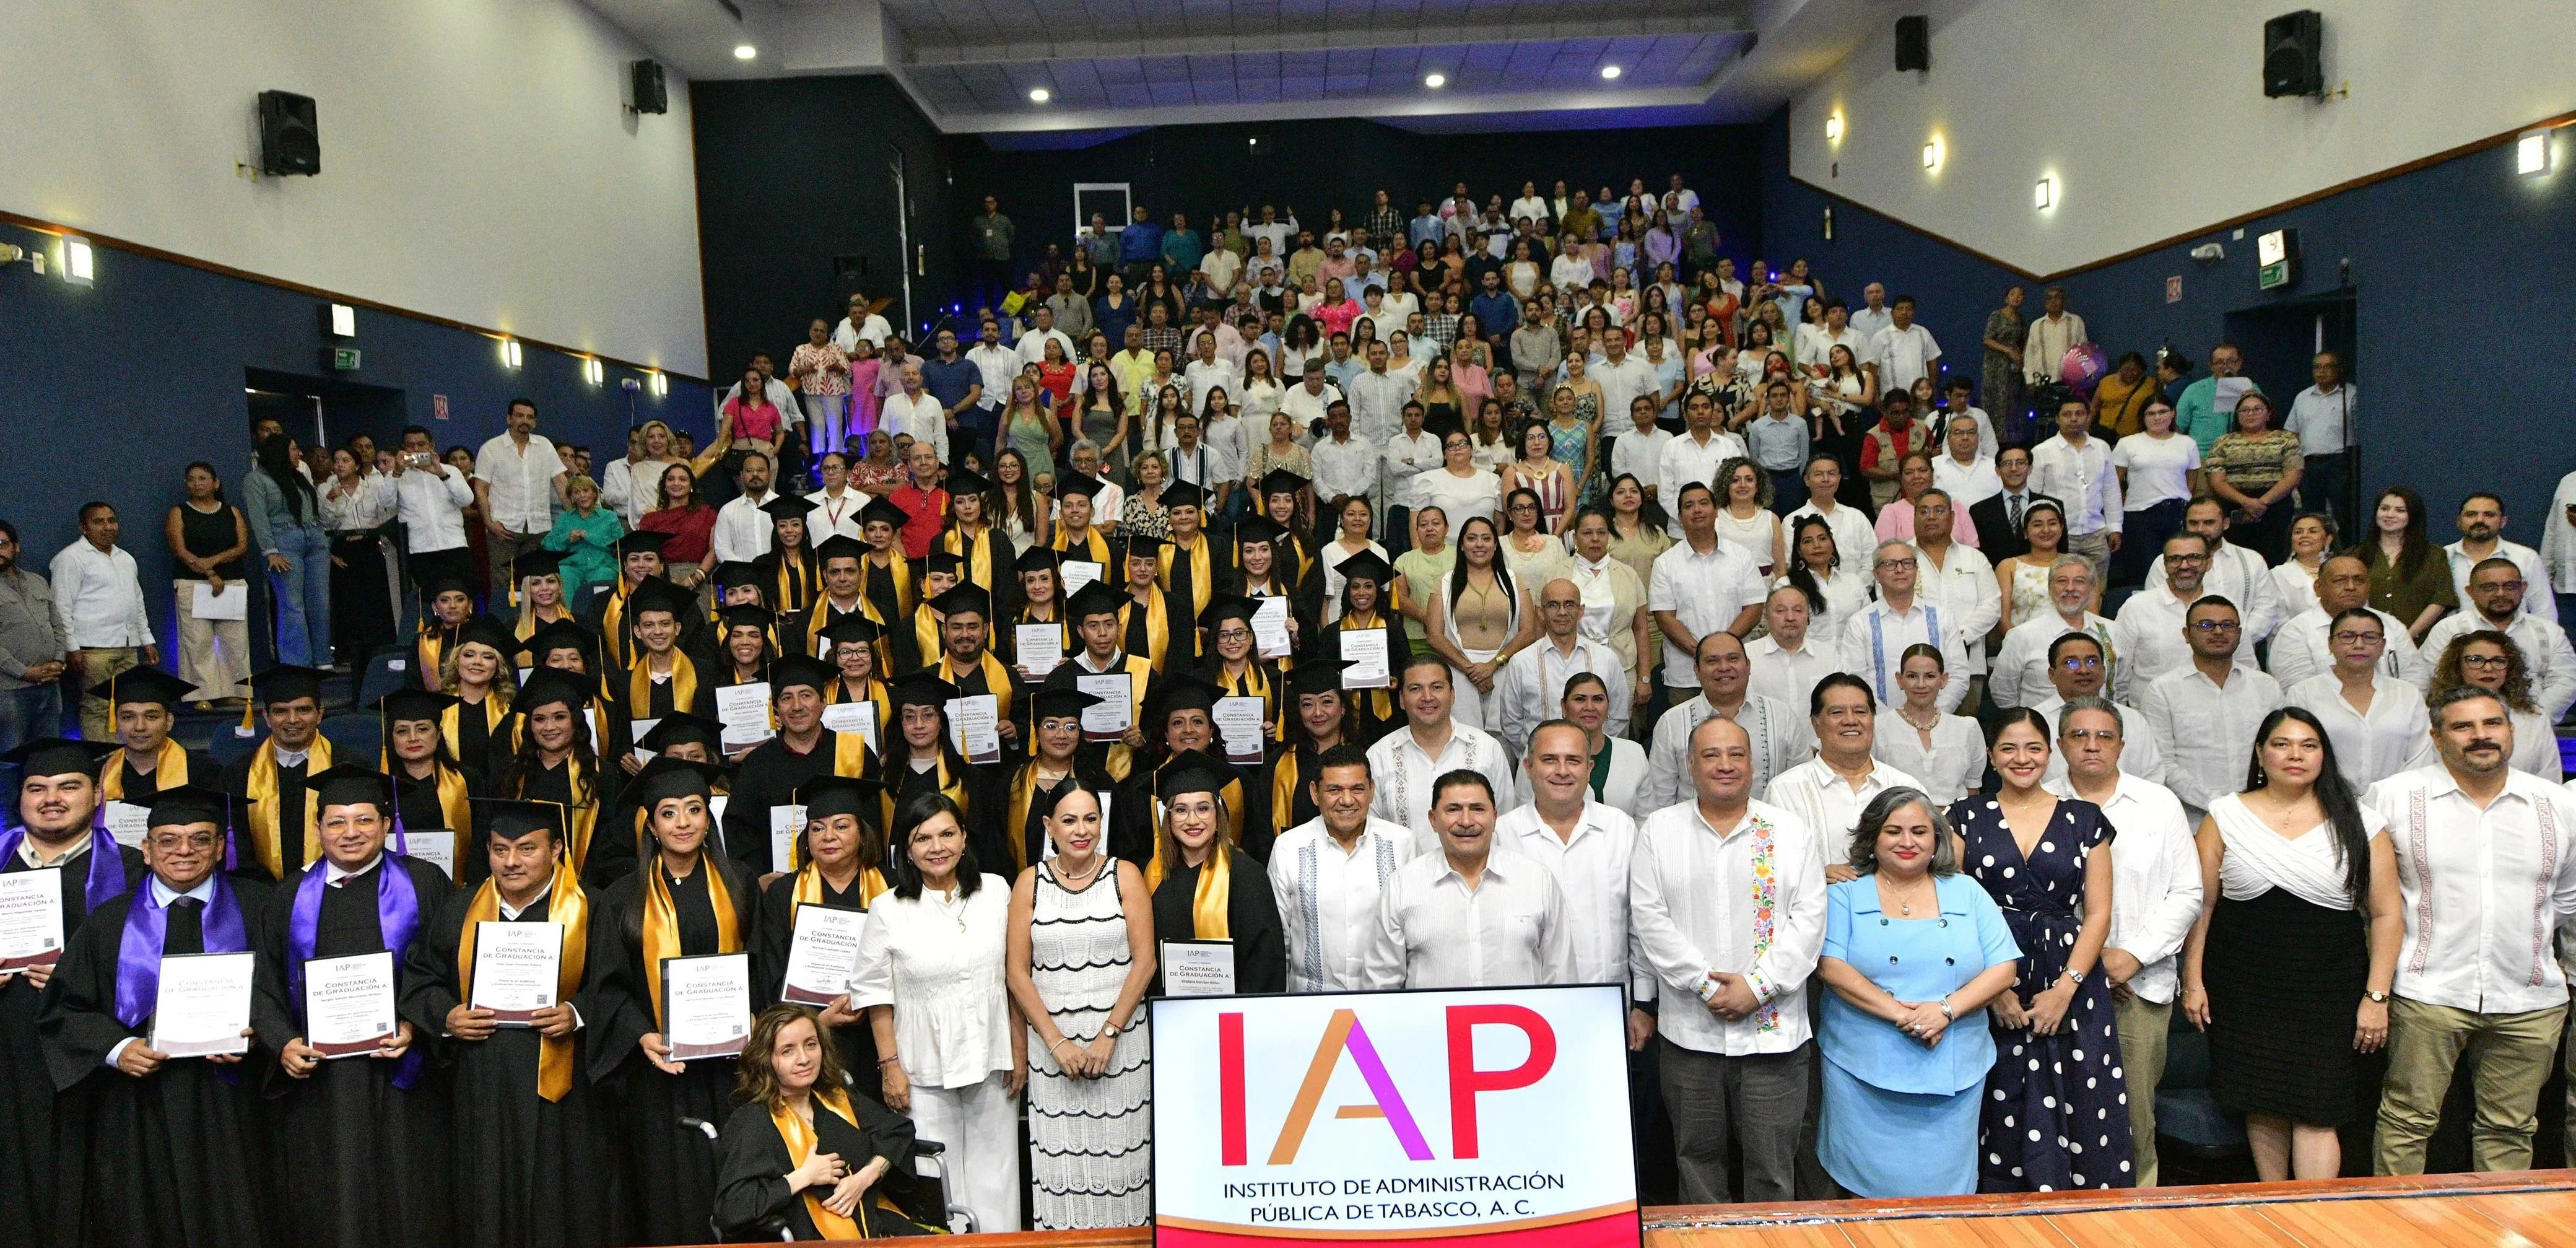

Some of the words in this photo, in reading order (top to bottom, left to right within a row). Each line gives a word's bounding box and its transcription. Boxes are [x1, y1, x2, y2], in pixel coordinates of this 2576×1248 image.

[3, 879, 17, 888] IAP
[0, 894, 45, 903] ONSTANCIA
[0, 899, 47, 909] RADUACIÓN
[824, 915, 837, 923] IAP
[811, 930, 856, 941] CONSTANCIA
[811, 936, 858, 948] GRADUACIÓN
[495, 952, 547, 960] GRADUACIÓN
[336, 964, 350, 972] IAP
[1180, 971, 1224, 979] GRADUACIÓN
[325, 978, 377, 988] CONSTANCIA
[686, 980, 734, 988] CONSTANCIA
[326, 984, 380, 995] GRADUACIÓN
[687, 987, 736, 995] GRADUACIÓN
[1218, 1004, 1556, 1166] IAP
[1224, 1180, 1336, 1198] INSTITUTO
[1344, 1179, 1371, 1195] DE
[1375, 1171, 1564, 1194] ADMINISTRACIÓN
[1251, 1203, 1339, 1222] PÚBLICA
[1346, 1205, 1373, 1220] DE
[1377, 1202, 1481, 1219] TABASCO,
[1490, 1200, 1509, 1216] A.
[1515, 1199, 1535, 1215] C.
